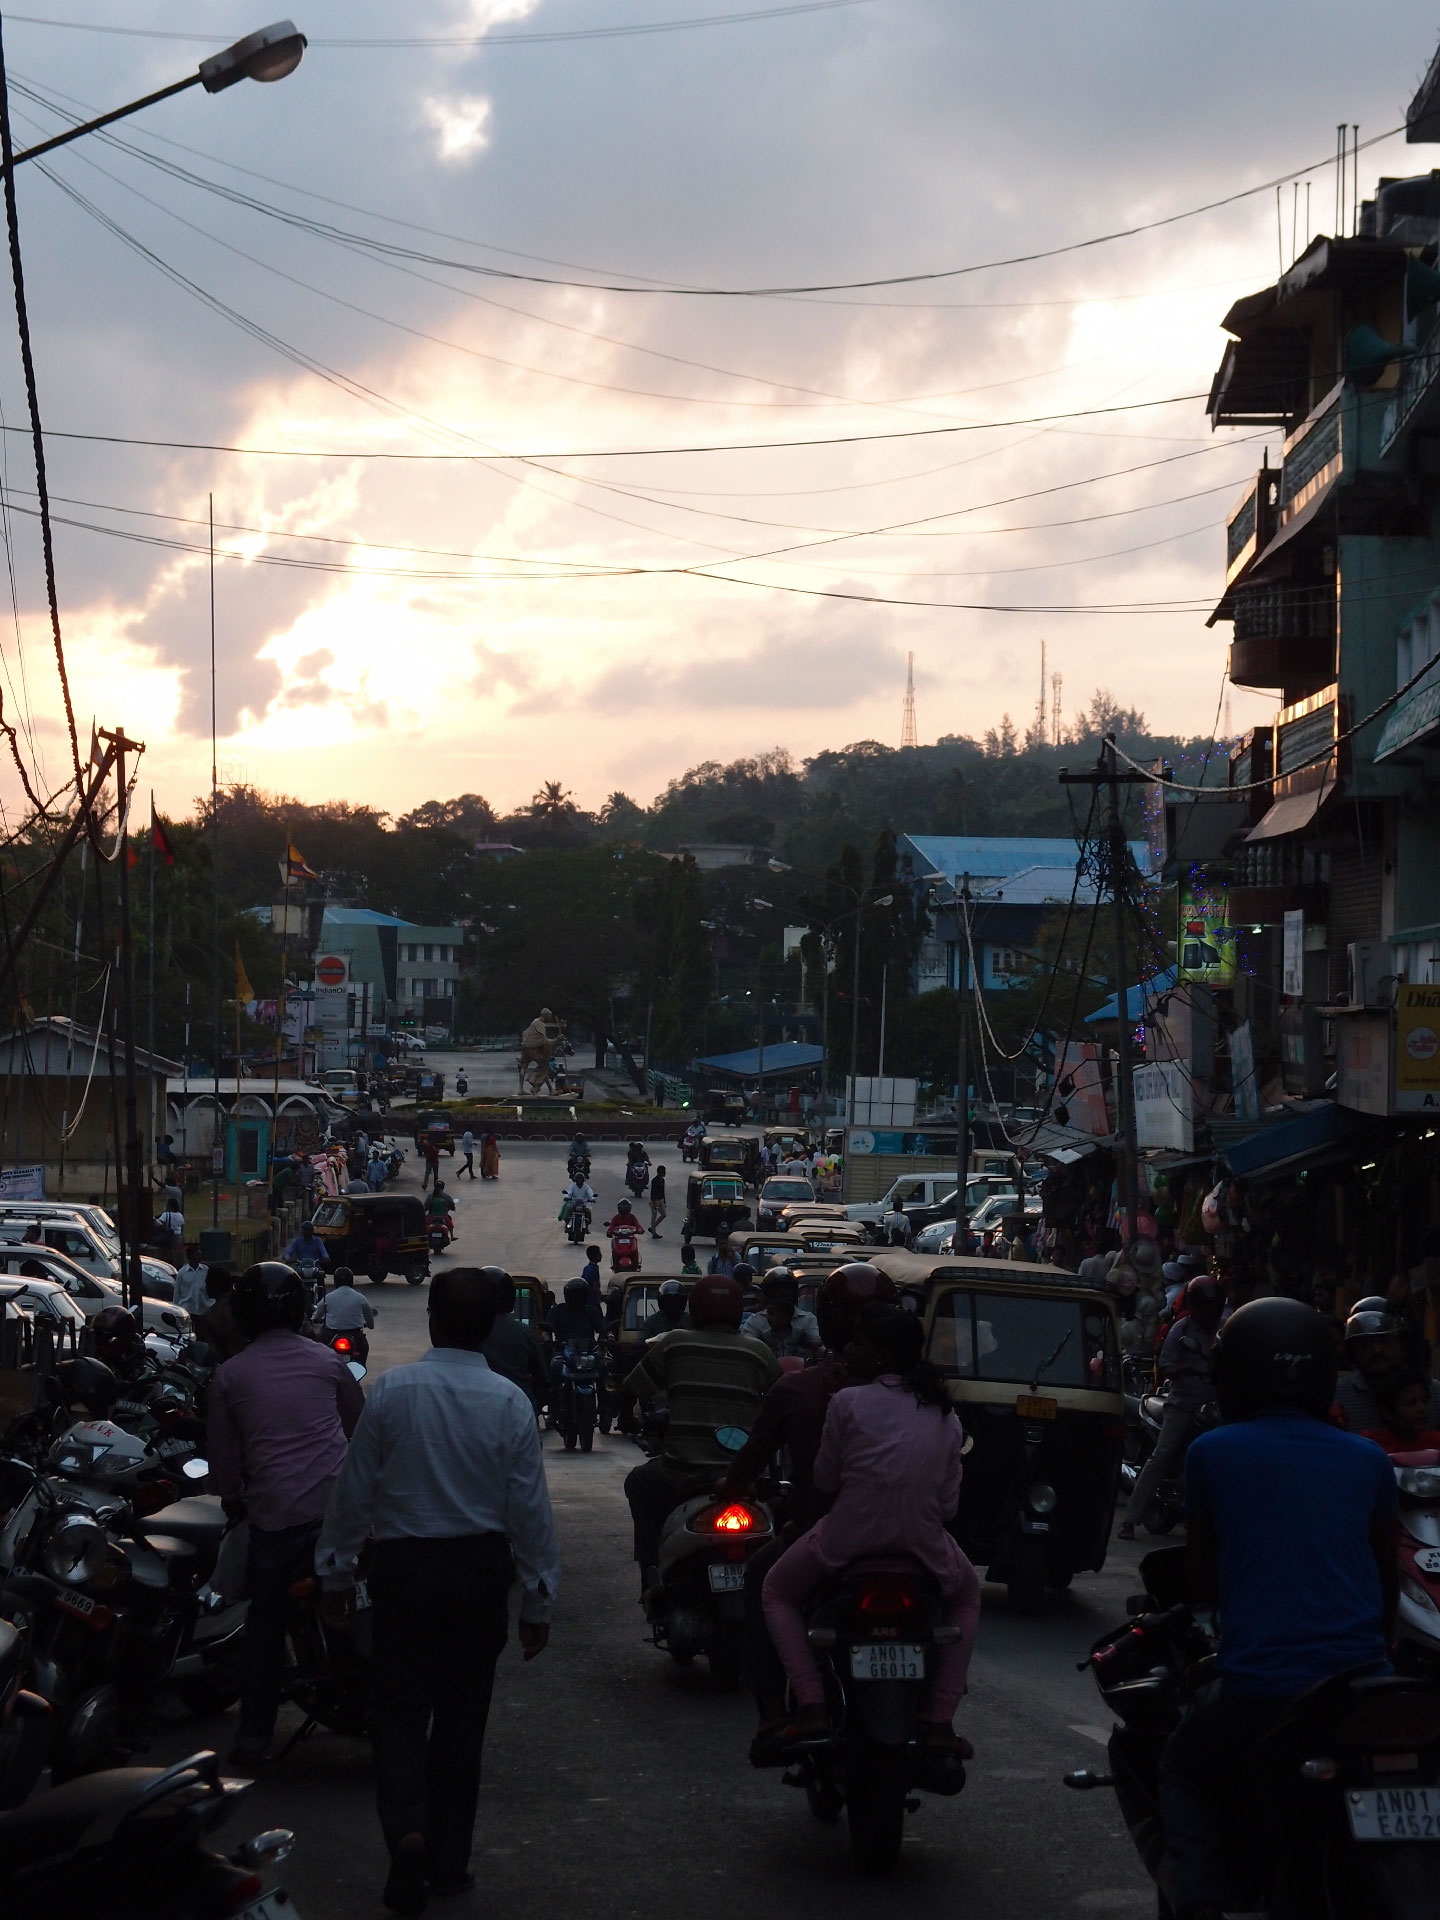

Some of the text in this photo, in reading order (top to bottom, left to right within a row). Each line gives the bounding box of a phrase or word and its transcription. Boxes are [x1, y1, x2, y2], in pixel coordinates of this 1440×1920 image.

[315, 986, 346, 994] IndianOil
[63, 1591, 92, 1613] 5669
[871, 1626, 898, 1638] ARS
[870, 1646, 905, 1662] AN01
[870, 1662, 917, 1677] G6013
[1377, 1790, 1430, 1813] AN01
